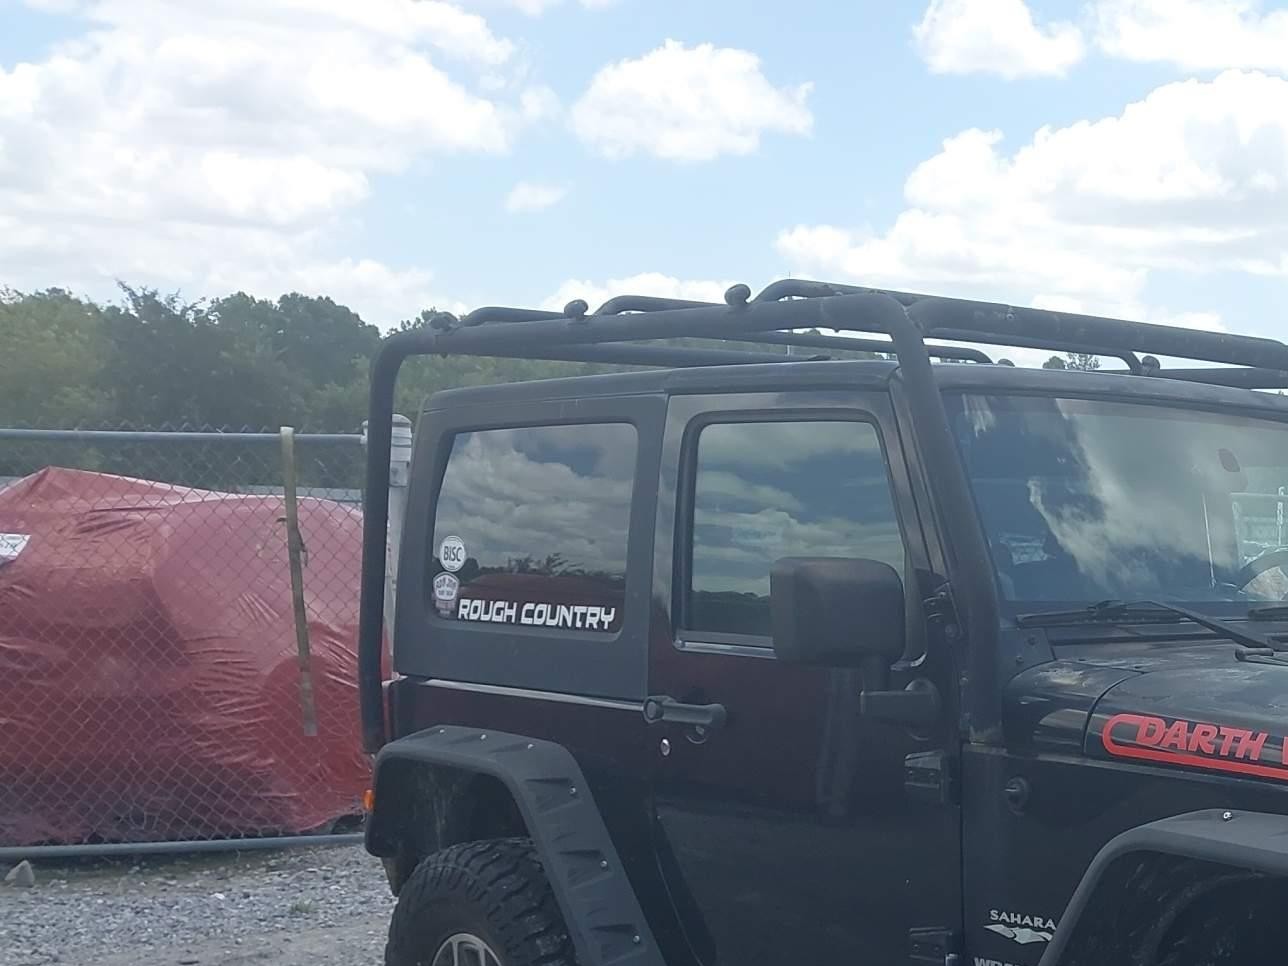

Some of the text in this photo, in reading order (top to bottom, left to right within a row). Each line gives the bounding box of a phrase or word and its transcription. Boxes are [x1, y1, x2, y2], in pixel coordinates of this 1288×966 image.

[443, 546, 462, 562] BISC
[458, 599, 616, 630] ROUGH COUNTRY
[1135, 715, 1269, 761] DARTH
[990, 910, 1056, 930] SAHARA
